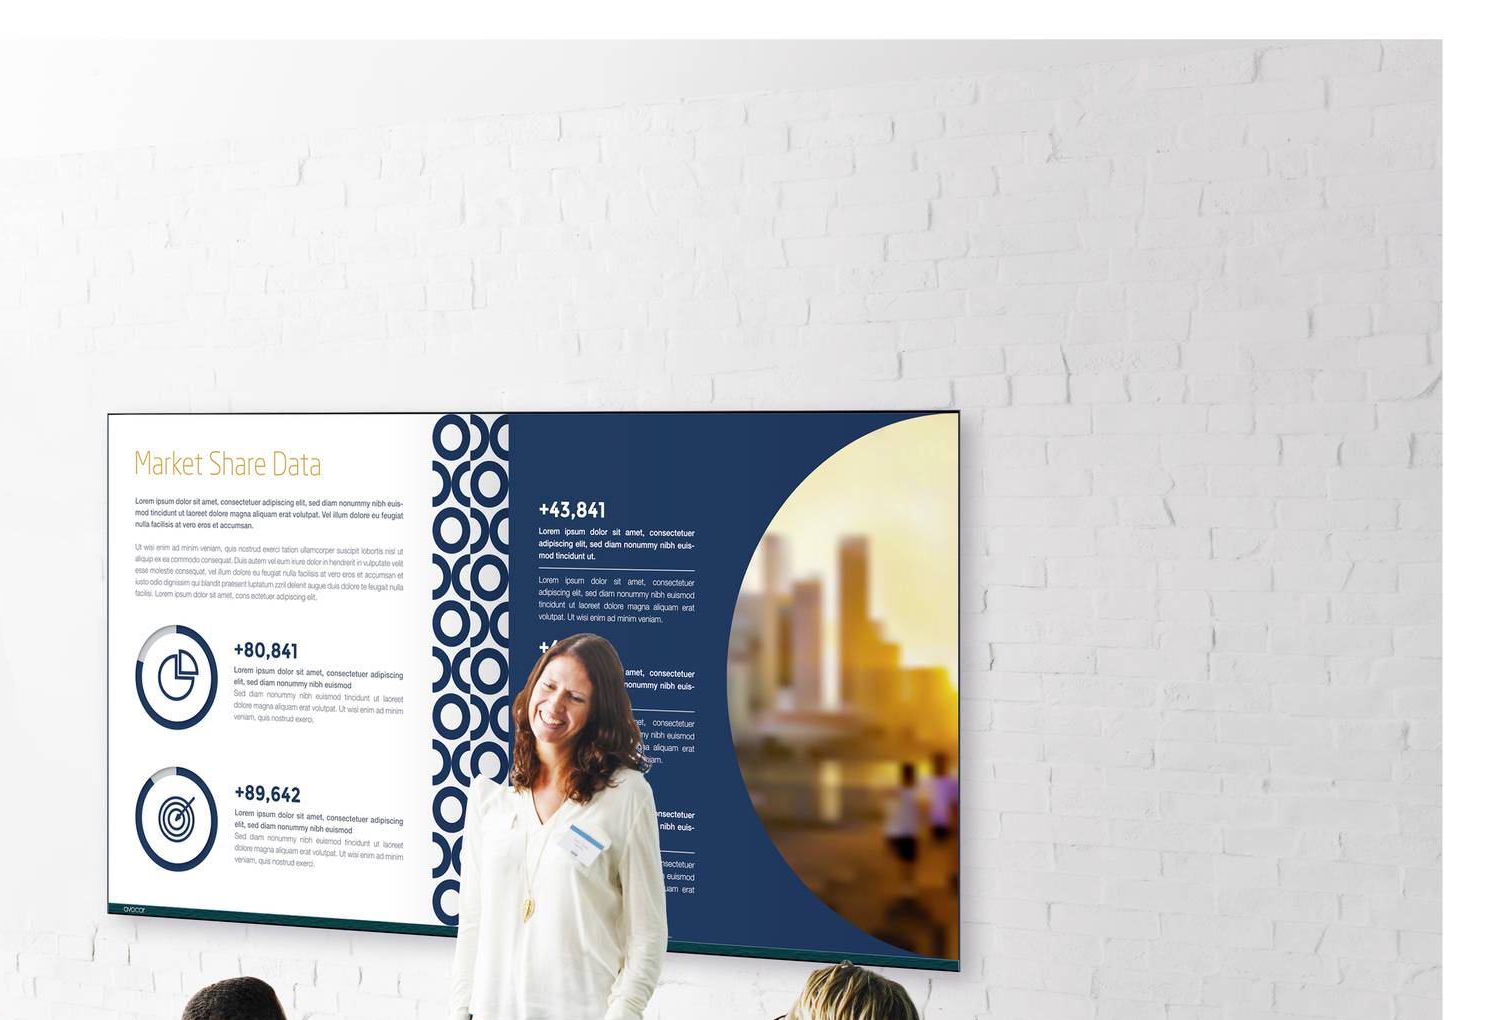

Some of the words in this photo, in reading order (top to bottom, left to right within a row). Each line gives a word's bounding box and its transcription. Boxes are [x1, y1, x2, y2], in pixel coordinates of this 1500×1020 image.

[135, 450, 203, 476] Market
[209, 450, 265, 476] Share
[273, 450, 320, 476] Data
[134, 497, 154, 505] Lorem
[155, 497, 174, 507] ipsum
[175, 497, 192, 505] dolor
[201, 497, 219, 506] amet,
[220, 498, 261, 506] consectetuer
[262, 498, 294, 509] adipiscing
[295, 498, 307, 507] elit,
[308, 498, 320, 507] sed
[321, 499, 337, 507] diam
[338, 501, 370, 509] nonummy
[371, 499, 386, 507] nibh
[386, 499, 403, 508] euis-
[134, 508, 149, 517] mod
[150, 509, 177, 517] tincidunt
[178, 509, 185, 517] ut
[185, 509, 207, 517] laoreet
[208, 509, 228, 518] dolore
[229, 511, 251, 520] magna
[252, 510, 277, 520] aliquam
[278, 510, 291, 518] erat
[292, 510, 320, 520] volutpat.
[321, 510, 331, 518] Vel
[332, 510, 348, 519] illum
[349, 510, 370, 519] dolore
[381, 511, 403, 521] feugiat
[539, 501, 605, 520] +43,841
[134, 520, 150, 528] nulla
[150, 520, 173, 528] facilisis
[174, 520, 181, 528] at
[212, 520, 218, 529] et
[538, 527, 560, 535] Lorem
[564, 527, 585, 538] ipsum
[589, 528, 608, 536] dolor
[612, 528, 620, 536] sit
[624, 528, 644, 537] amet,
[649, 528, 695, 537] consectetuer
[538, 539, 573, 550] adipiscing
[575, 540, 587, 549] elit,
[589, 540, 602, 548] sed
[604, 540, 621, 548] diam
[623, 542, 658, 551] nonummy
[659, 541, 675, 549] nibh
[677, 541, 694, 550] euis-
[538, 551, 554, 559] mod
[555, 551, 585, 560] tincidunt
[586, 552, 595, 560] ut.
[538, 576, 559, 584] Lorem
[564, 576, 584, 587] ipsum
[590, 577, 607, 585] dolor
[613, 577, 621, 586] sit
[652, 578, 694, 587] consectetuer
[538, 588, 570, 599] adipiscing
[584, 589, 597, 597] sed
[598, 589, 615, 598] diam
[616, 591, 649, 600] nonummy
[650, 590, 665, 598] nibh
[666, 590, 695, 599] euismod
[538, 600, 565, 608] tincidunt
[568, 600, 575, 609] ut
[578, 601, 600, 609] laoreet
[603, 601, 624, 610] dolore
[627, 604, 650, 612] magna
[652, 602, 678, 613] aliquam
[681, 603, 694, 611] erat
[567, 613, 574, 621] Ut
[576, 613, 588, 622] wisi
[589, 613, 605, 622] enim
[606, 614, 615, 622] ad
[616, 614, 636, 622] minim
[234, 642, 298, 660] +80,841
[233, 666, 253, 674] Lorem
[255, 666, 275, 677] ipsum
[276, 667, 294, 676] dolor
[296, 668, 304, 676] sit
[326, 669, 368, 678] consectetuer
[370, 670, 403, 681] adipiscing
[625, 669, 644, 677] amet,
[246, 678, 258, 686] sed
[259, 678, 275, 687] diam
[276, 680, 308, 690] nonummy
[308, 680, 323, 688] nibh
[324, 680, 351, 689] euismod
[653, 744, 678, 752] aliquam
[235, 785, 300, 803] +89,642
[234, 808, 254, 817] Lorem
[256, 810, 276, 821] ipsum
[277, 810, 294, 819] dolor
[296, 811, 304, 820] sit
[326, 813, 368, 823] consectetuer
[370, 815, 403, 826] adipiscing
[247, 821, 259, 829] sed
[260, 821, 276, 830] diam
[277, 824, 308, 834] nonummy
[309, 824, 324, 833] nibh
[324, 825, 352, 834] euismod
